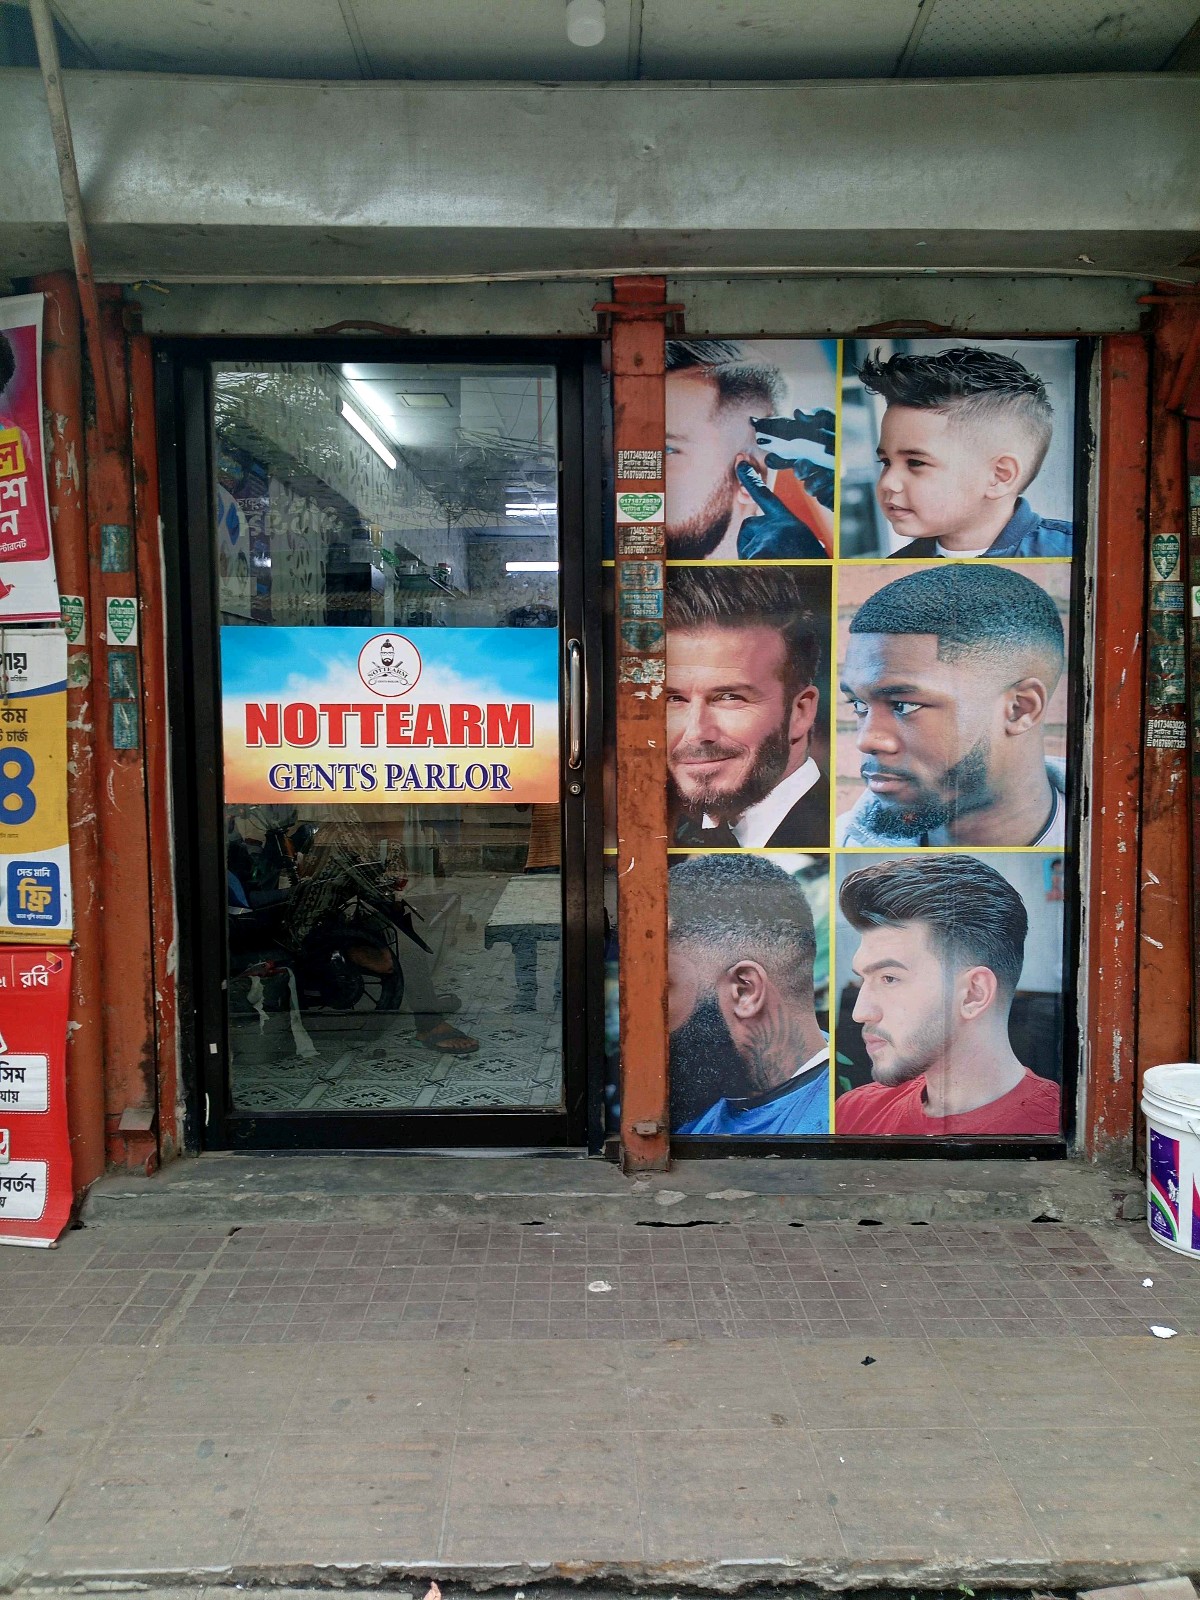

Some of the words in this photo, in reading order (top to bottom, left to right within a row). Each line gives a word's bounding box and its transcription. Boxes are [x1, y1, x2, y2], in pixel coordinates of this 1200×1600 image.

[1, 708, 28, 723] কম
[245, 702, 533, 747] NOTTEARM
[6, 729, 28, 742] চার্জ
[268, 762, 377, 791] GENTS
[384, 762, 512, 791] PARLOR
[19, 964, 49, 988] রবি
